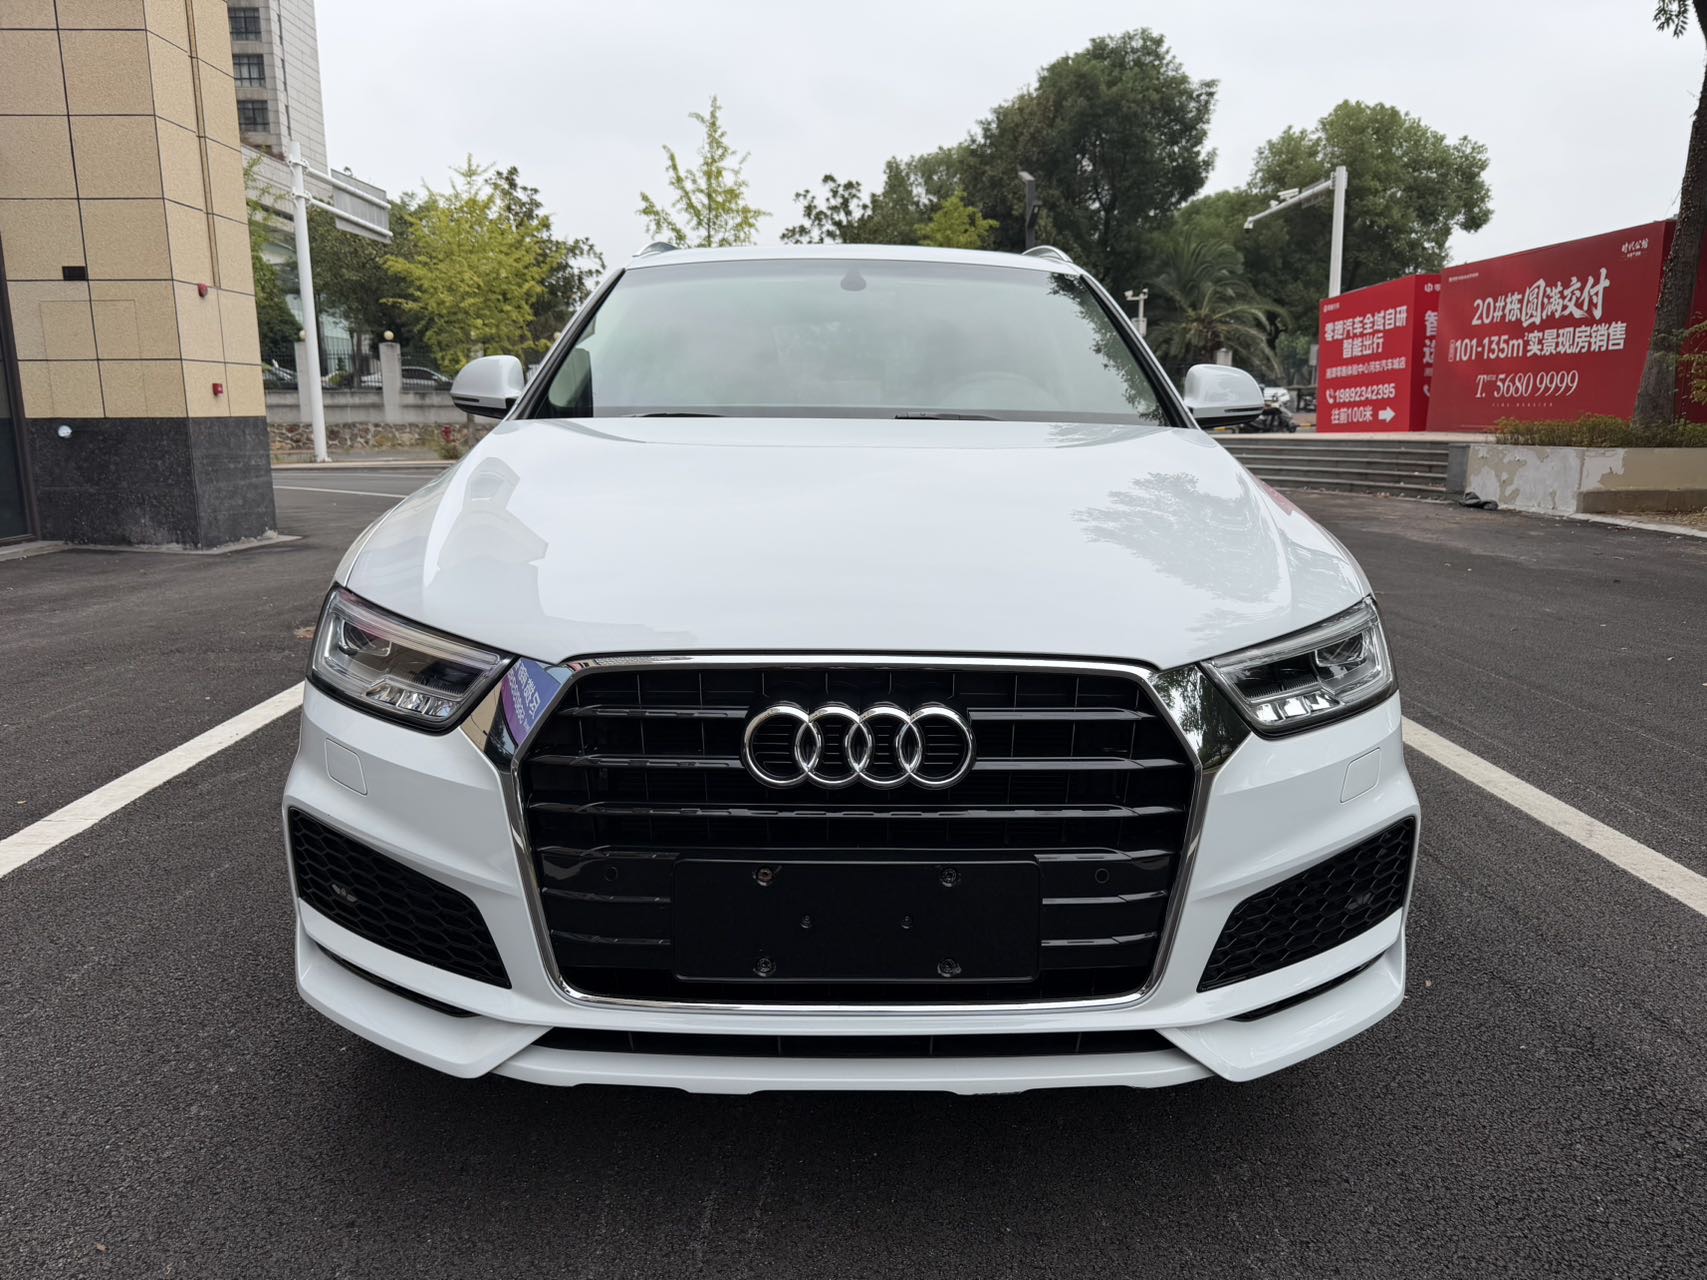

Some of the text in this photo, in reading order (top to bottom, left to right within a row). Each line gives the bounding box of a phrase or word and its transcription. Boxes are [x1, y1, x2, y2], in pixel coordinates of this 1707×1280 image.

[1472, 267, 1610, 327] 20#栋圆满交付
[1325, 305, 1408, 342] 零跑汽车全域自研
[1342, 333, 1384, 359] 智能出行
[1494, 373, 1533, 398] 5680
[1536, 370, 1579, 397] 9999
[1331, 406, 1374, 425] 往前100米
